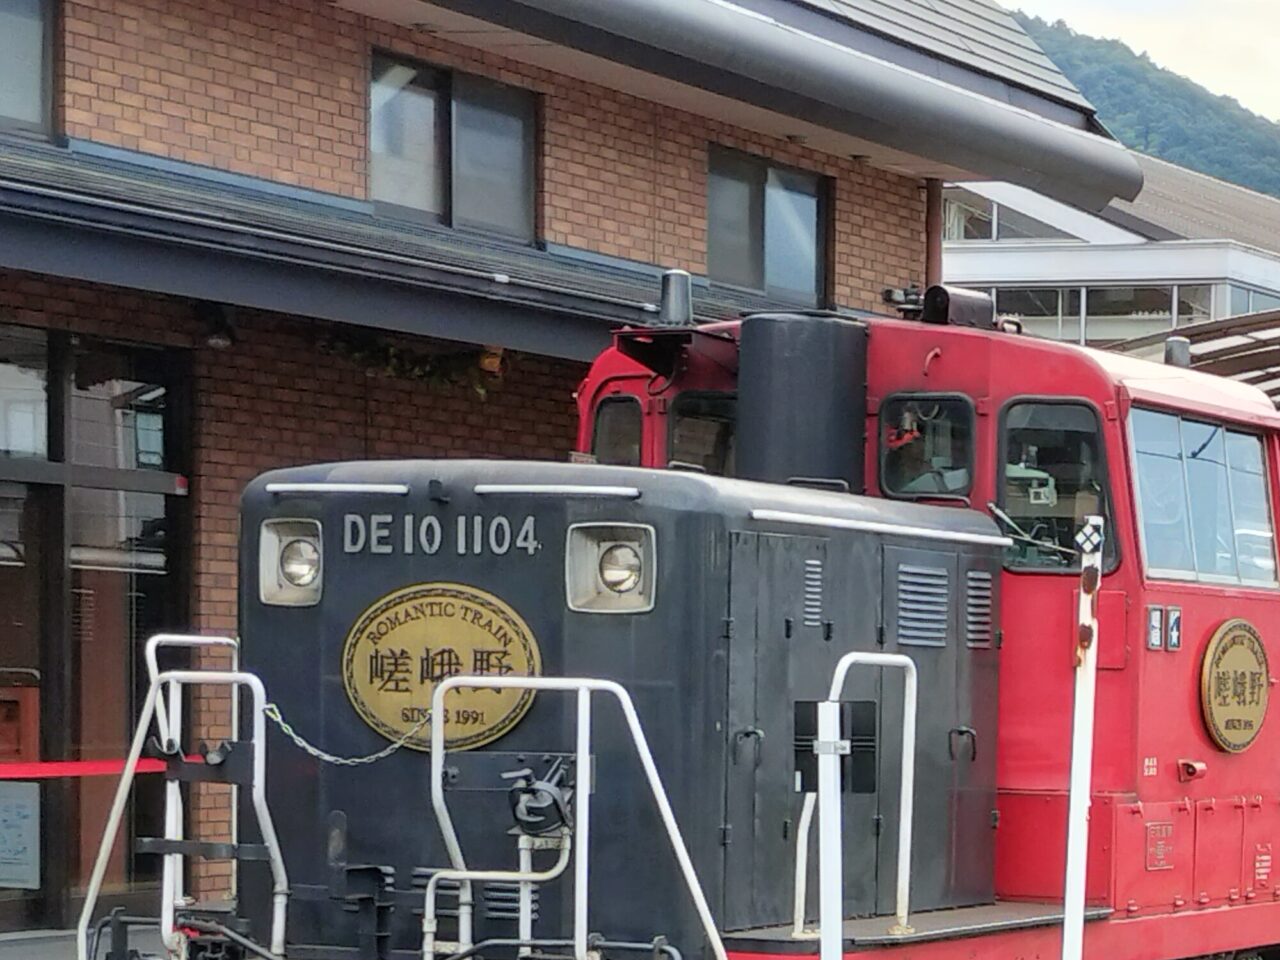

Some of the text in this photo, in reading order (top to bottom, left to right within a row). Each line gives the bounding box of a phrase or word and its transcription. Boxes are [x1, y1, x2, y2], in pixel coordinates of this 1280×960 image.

[343, 513, 540, 556] DE10 1104
[366, 601, 514, 649] ROMANTIC TRAIN
[454, 709, 486, 726] 1991
